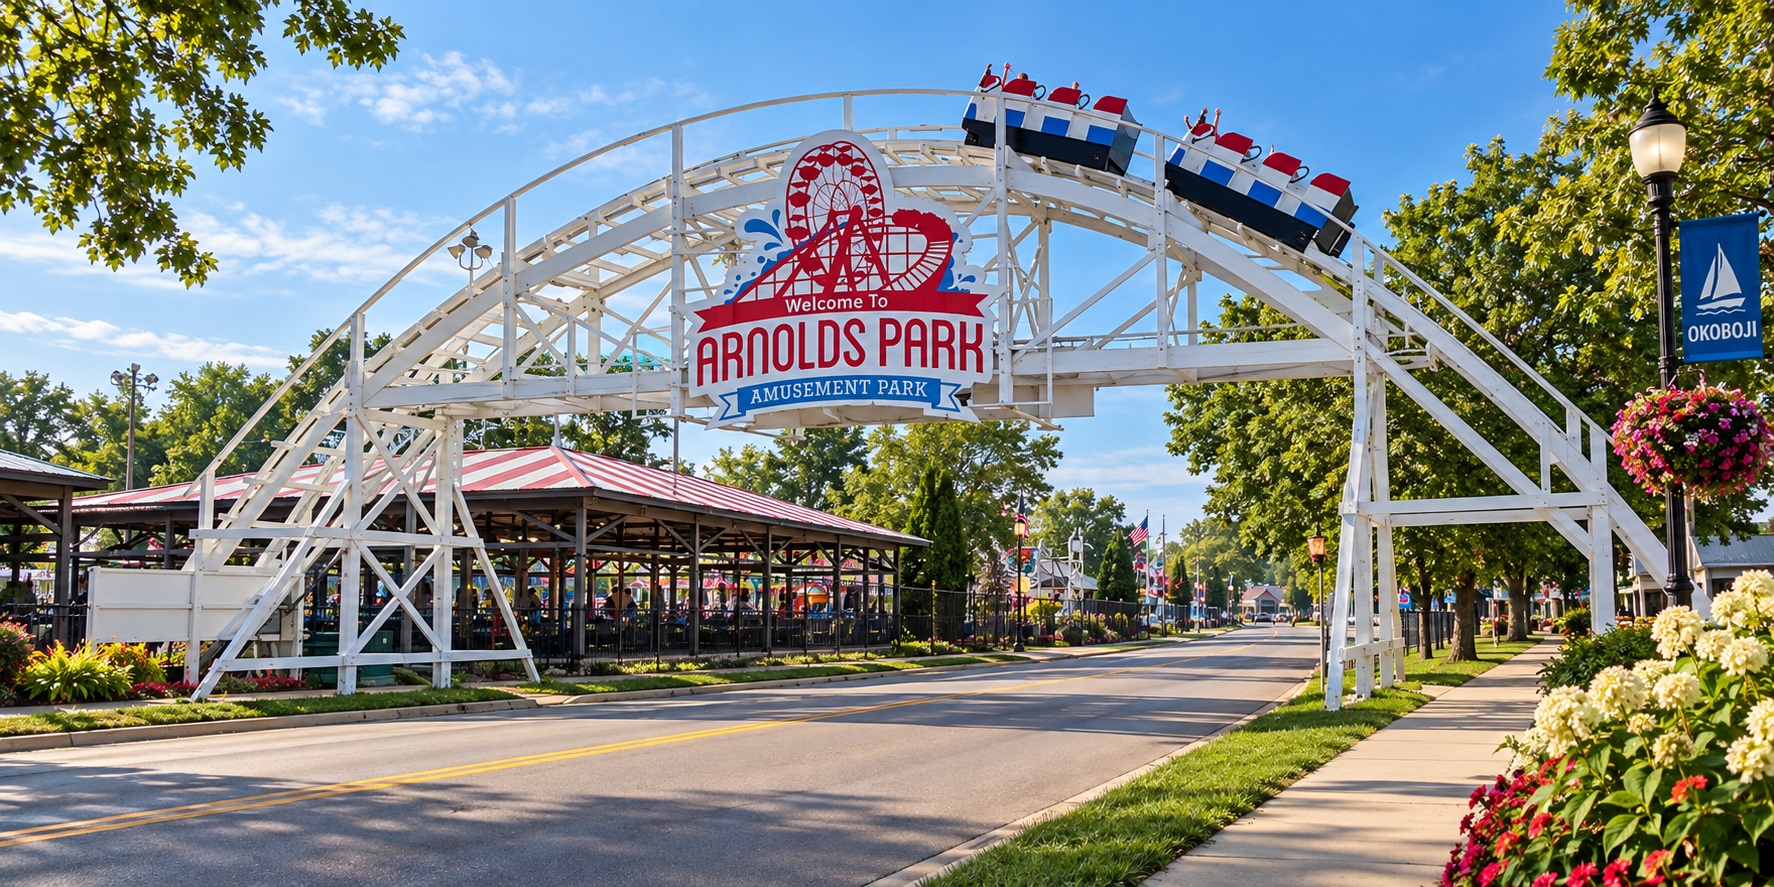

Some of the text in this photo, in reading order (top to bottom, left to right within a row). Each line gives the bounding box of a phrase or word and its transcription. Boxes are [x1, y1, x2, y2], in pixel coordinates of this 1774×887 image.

[785, 293, 888, 313] Welcome To
[1687, 320, 1757, 343] OKOBOJI
[696, 317, 984, 387] ARNOLDS PARK
[750, 379, 928, 405] AMUSEMENT PARK
